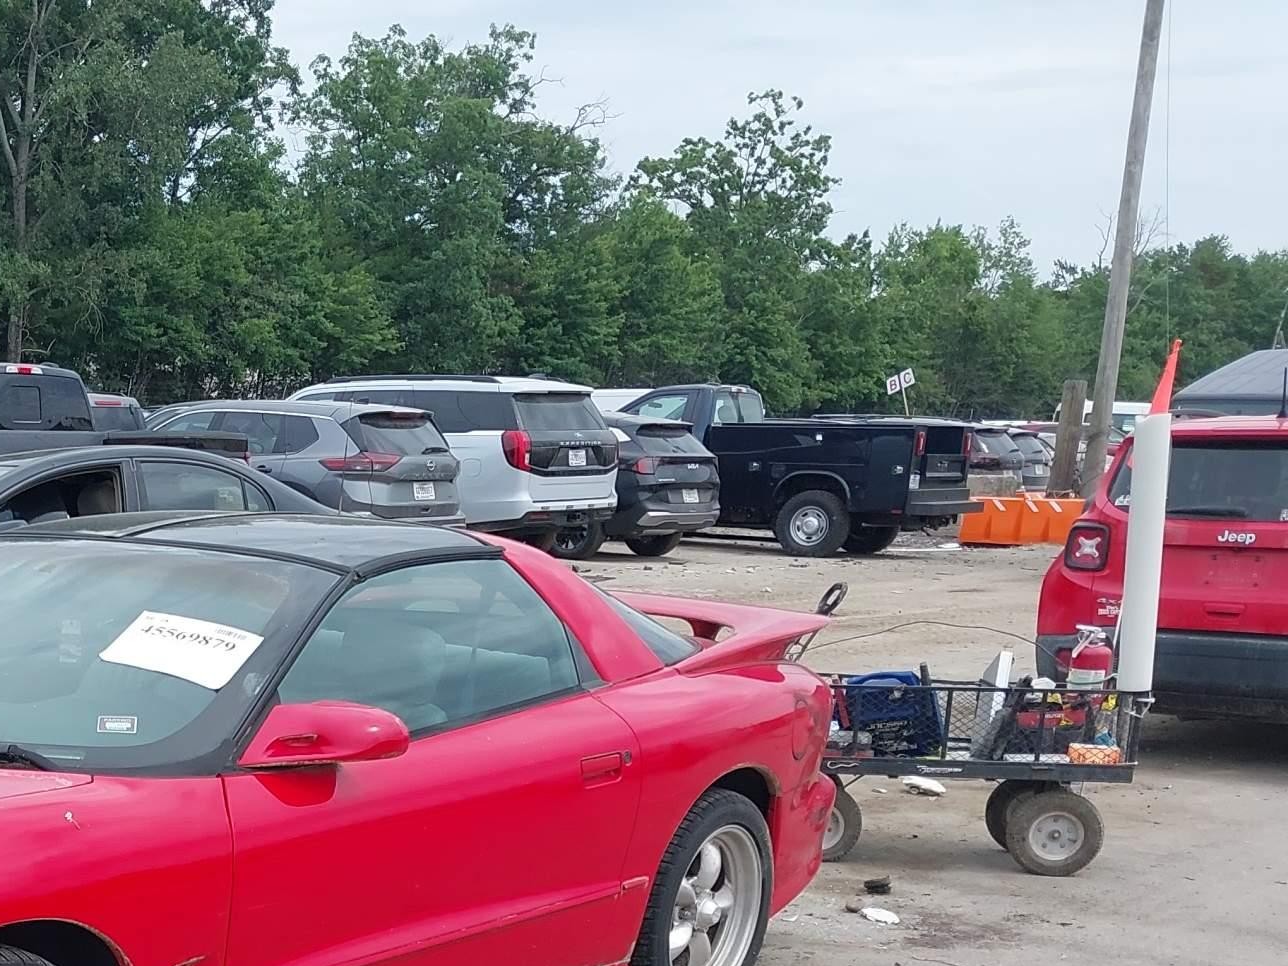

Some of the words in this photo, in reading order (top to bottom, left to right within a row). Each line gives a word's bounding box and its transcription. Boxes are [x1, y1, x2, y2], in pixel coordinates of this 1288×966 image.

[903, 372, 913, 384] C
[889, 379, 898, 392] B
[1217, 529, 1257, 545] Jeep
[140, 624, 237, 652] 45569879
